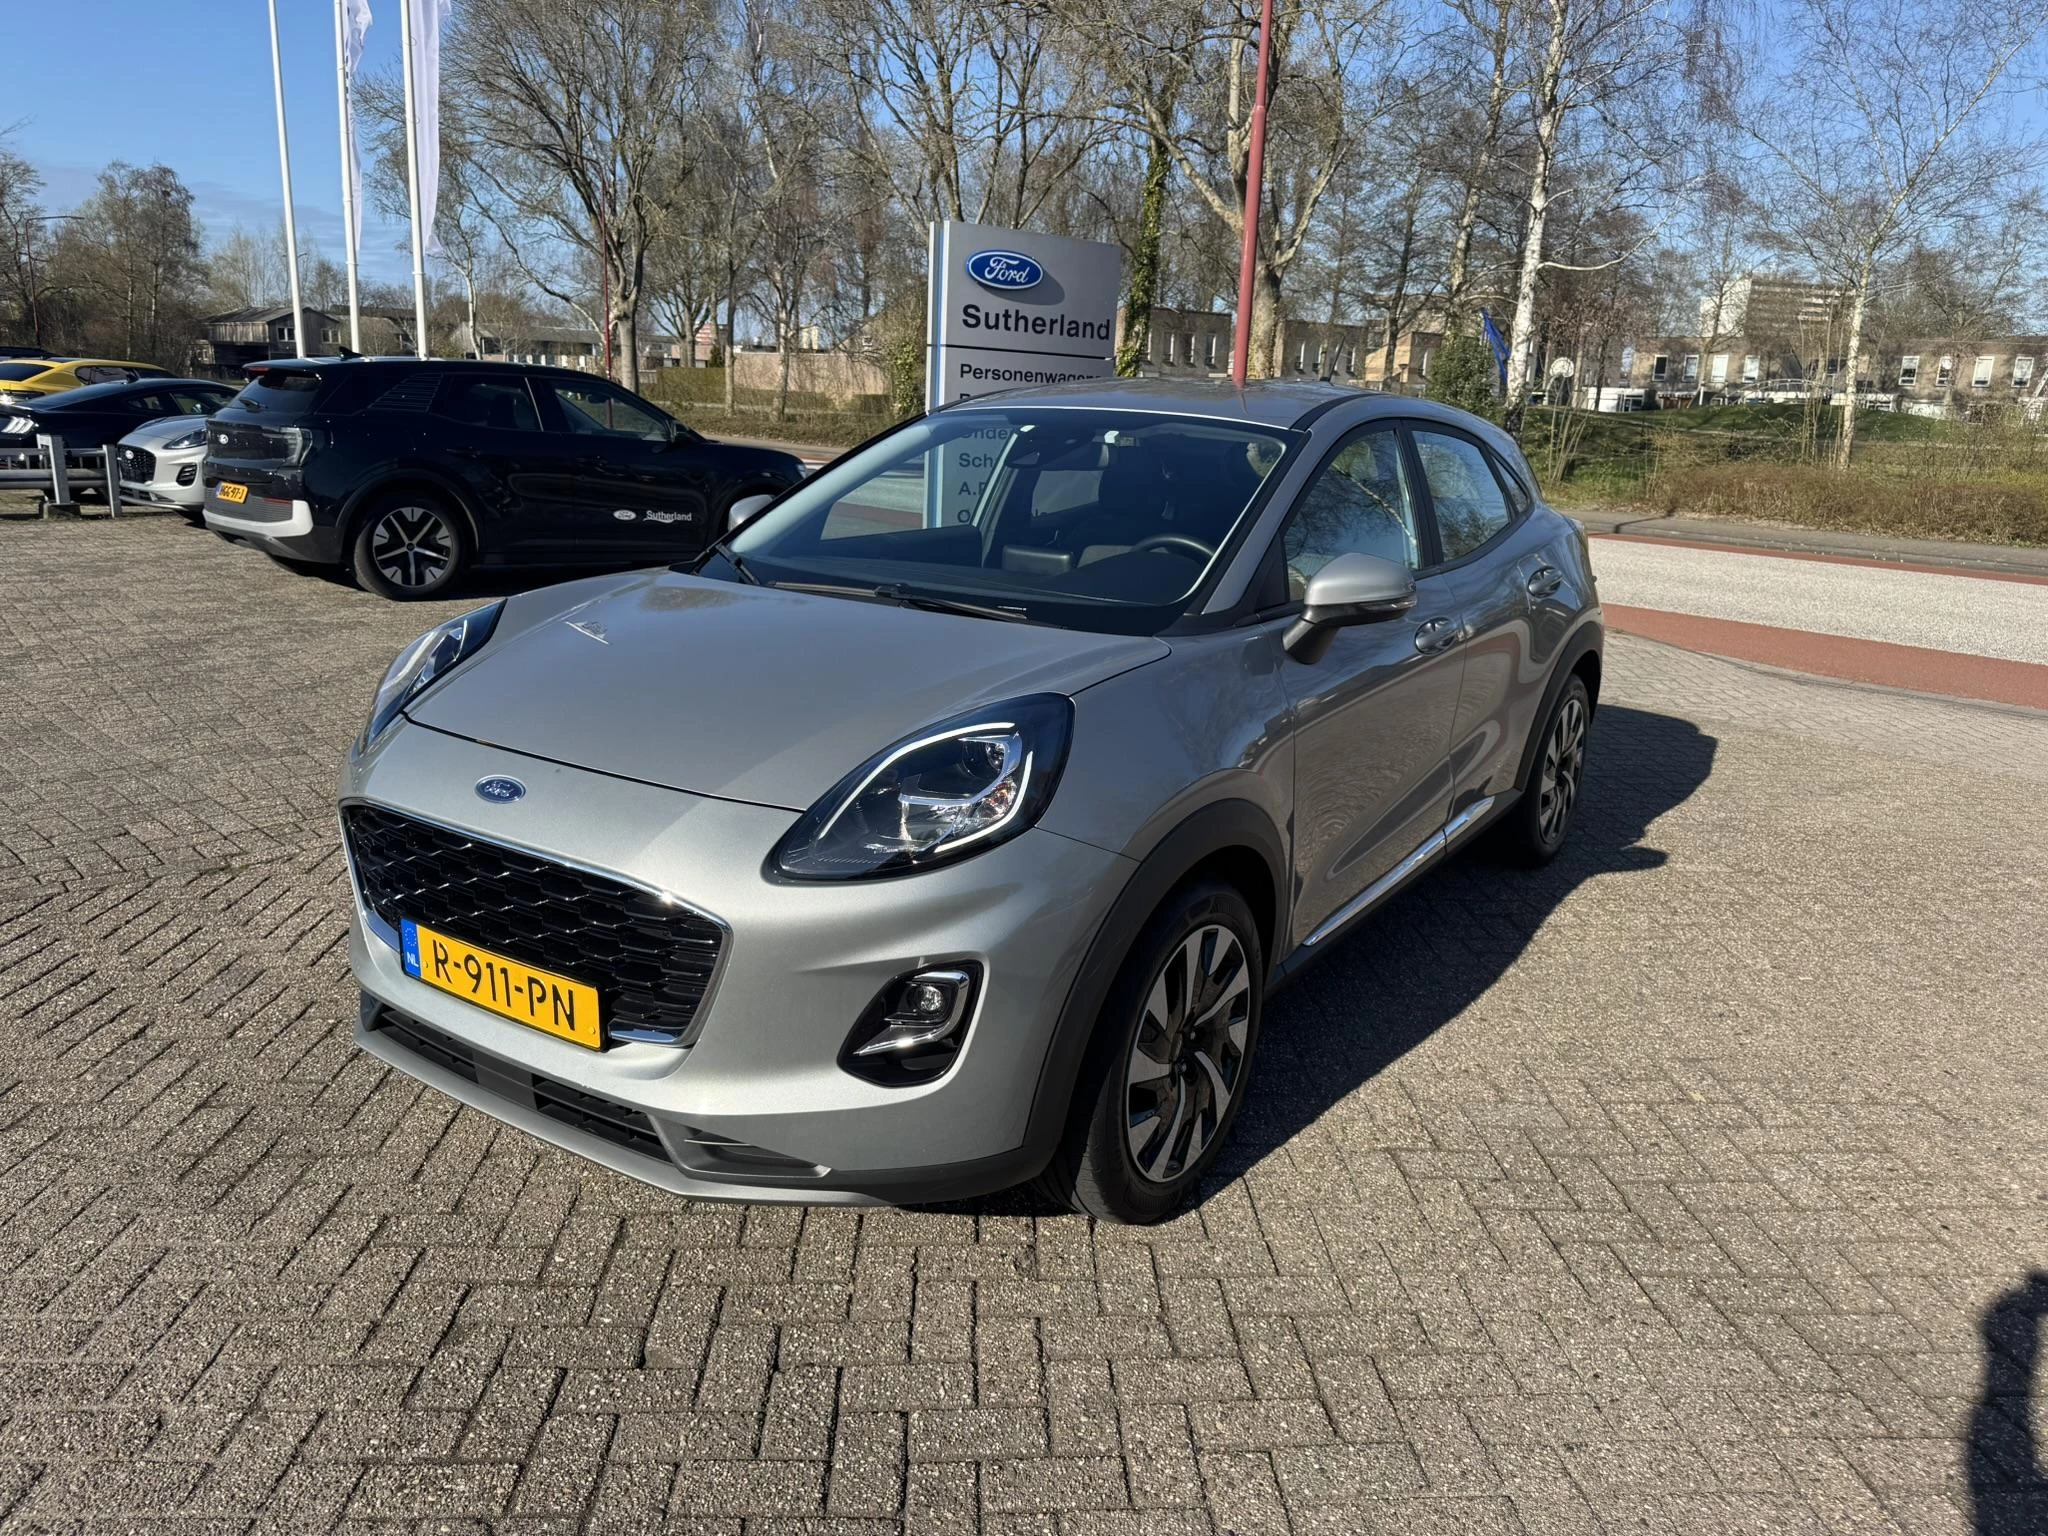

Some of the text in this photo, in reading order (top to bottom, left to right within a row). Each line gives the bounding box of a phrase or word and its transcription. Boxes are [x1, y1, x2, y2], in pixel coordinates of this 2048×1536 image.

[985, 256, 1030, 283] Ford
[962, 304, 1110, 341] Sutherland
[960, 363, 1101, 384] Personenwage
[646, 510, 692, 521] Sutherland
[406, 951, 419, 967] NL
[432, 939, 576, 1031] R-911-PN
